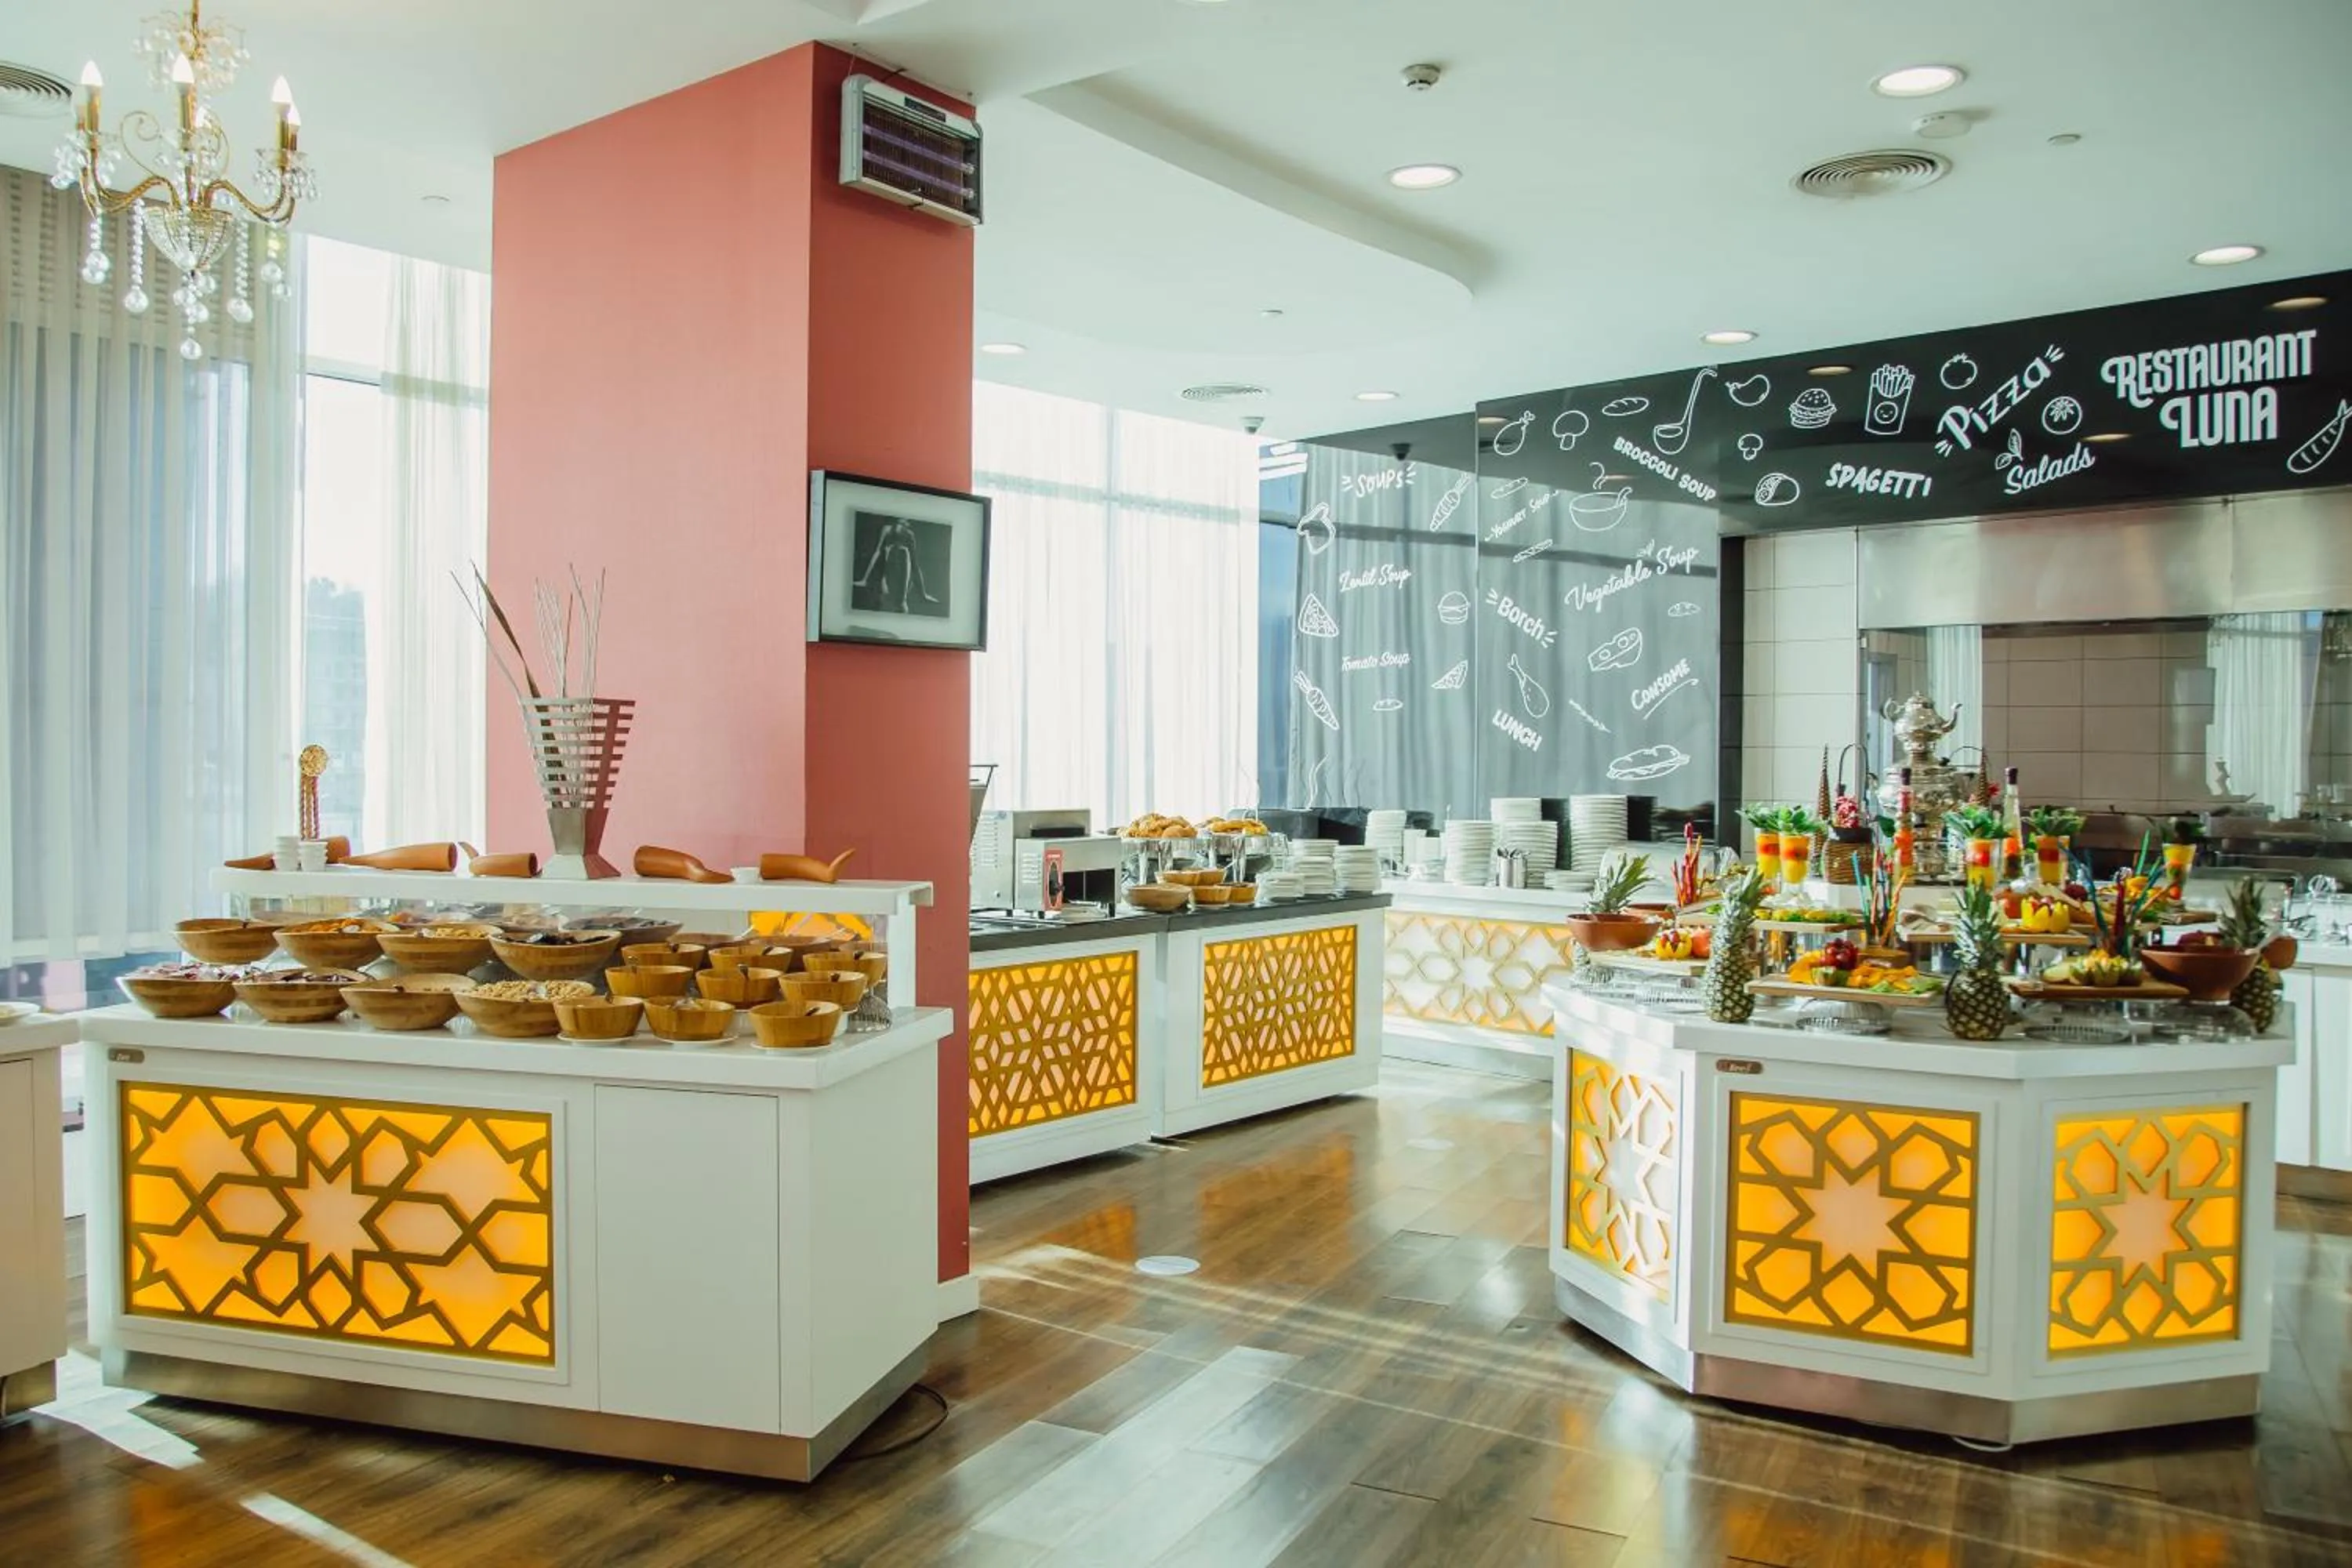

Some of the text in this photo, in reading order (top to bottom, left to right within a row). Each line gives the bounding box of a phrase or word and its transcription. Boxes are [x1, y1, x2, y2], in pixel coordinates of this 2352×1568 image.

[2100, 328, 2318, 408] RESTAURANT
[1936, 357, 2052, 450] Pizza
[2159, 387, 2278, 448] LUNA
[1613, 436, 1717, 502] BROCCOLI SOUP
[1824, 462, 1933, 499] SPAGETTI
[2003, 441, 2096, 495] Salads
[1378, 563, 1412, 590] Soup
[1564, 545, 1700, 614] Vegetable Soup
[1497, 595, 1546, 641] Borch
[1379, 651, 1411, 668] Soup
[1631, 658, 1691, 710] CONSOME
[1492, 708, 1543, 753] LUNCH
